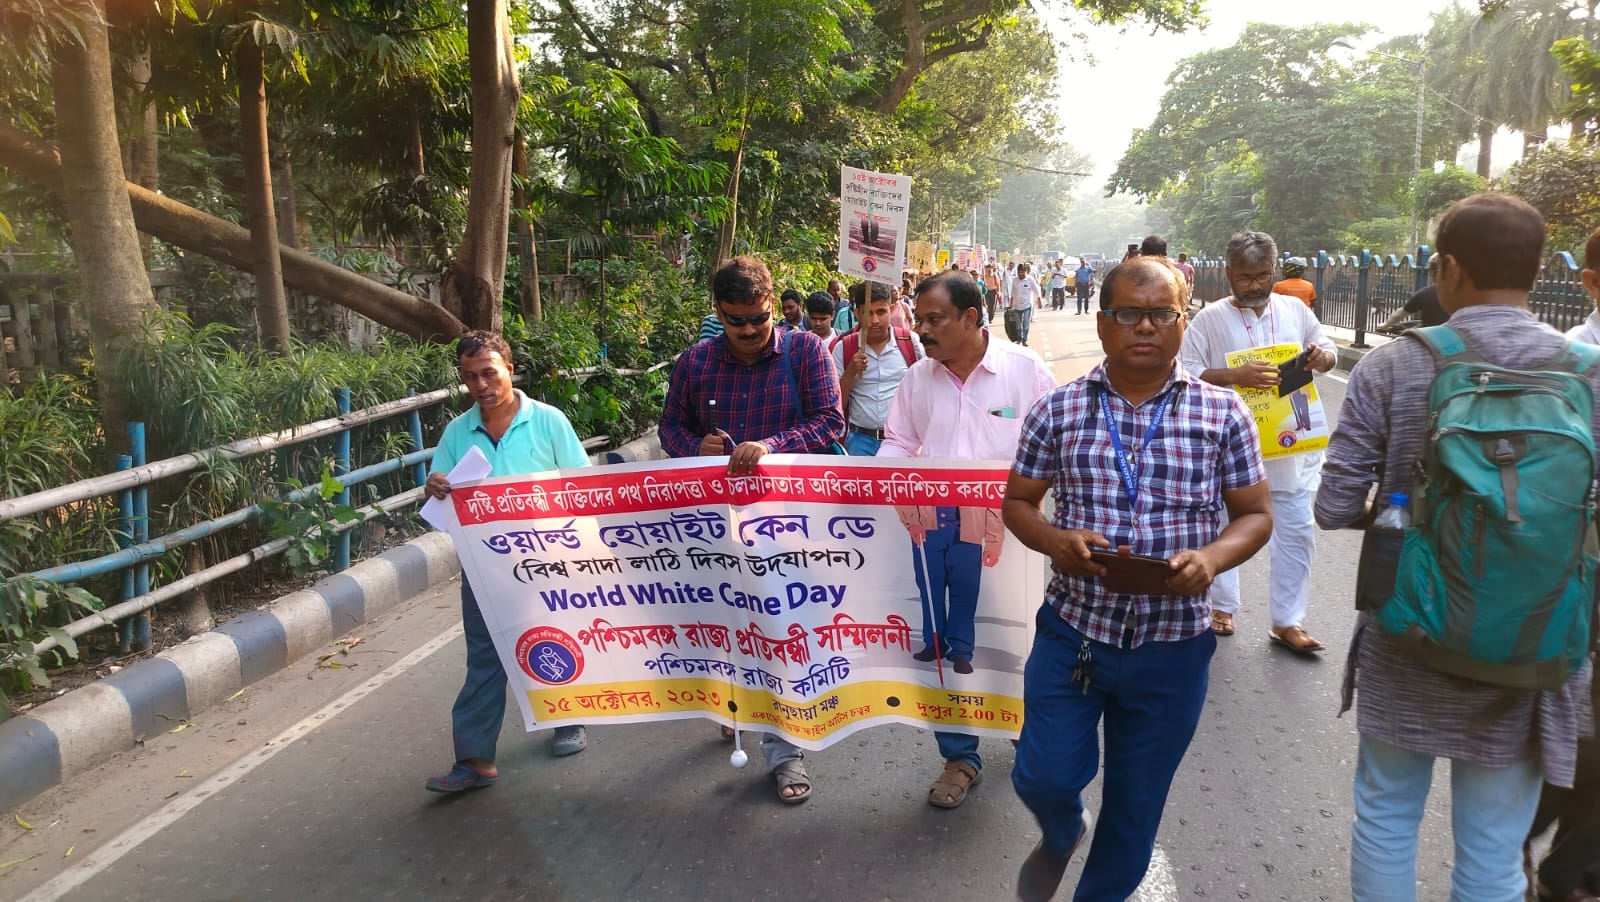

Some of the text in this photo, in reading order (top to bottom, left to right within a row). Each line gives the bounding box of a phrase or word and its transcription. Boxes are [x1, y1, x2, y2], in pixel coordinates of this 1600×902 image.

[465, 470, 1008, 522] দৃষ্টি প্রতিবন্ধী ব্যক্তিদের পথ নিরাপত্তা ও চলমানতার অধিকার সুনিশ্চিত করতে
[599, 509, 726, 549] হোয়াইট
[738, 514, 810, 546] কেন
[828, 515, 877, 540] ডে
[513, 558, 569, 584] (বিশ্ব
[573, 555, 623, 575] সাদা
[626, 548, 681, 572] লাঠি
[686, 547, 742, 574] দিবস
[540, 581, 847, 616] World White Cane Day
[578, 613, 913, 668] পশ্চিমবঙ্গ রাজ্য প্রতিবন্ধী সম্মিলনী
[644, 652, 851, 698] পশ্চিমবঙ্গ রাজ্য কমিটি
[544, 688, 721, 714] ১৫ অক্টোবর, ২০২৩
[916, 701, 1019, 724] দুপুর 2.00 টা
[947, 693, 985, 706] সময়
